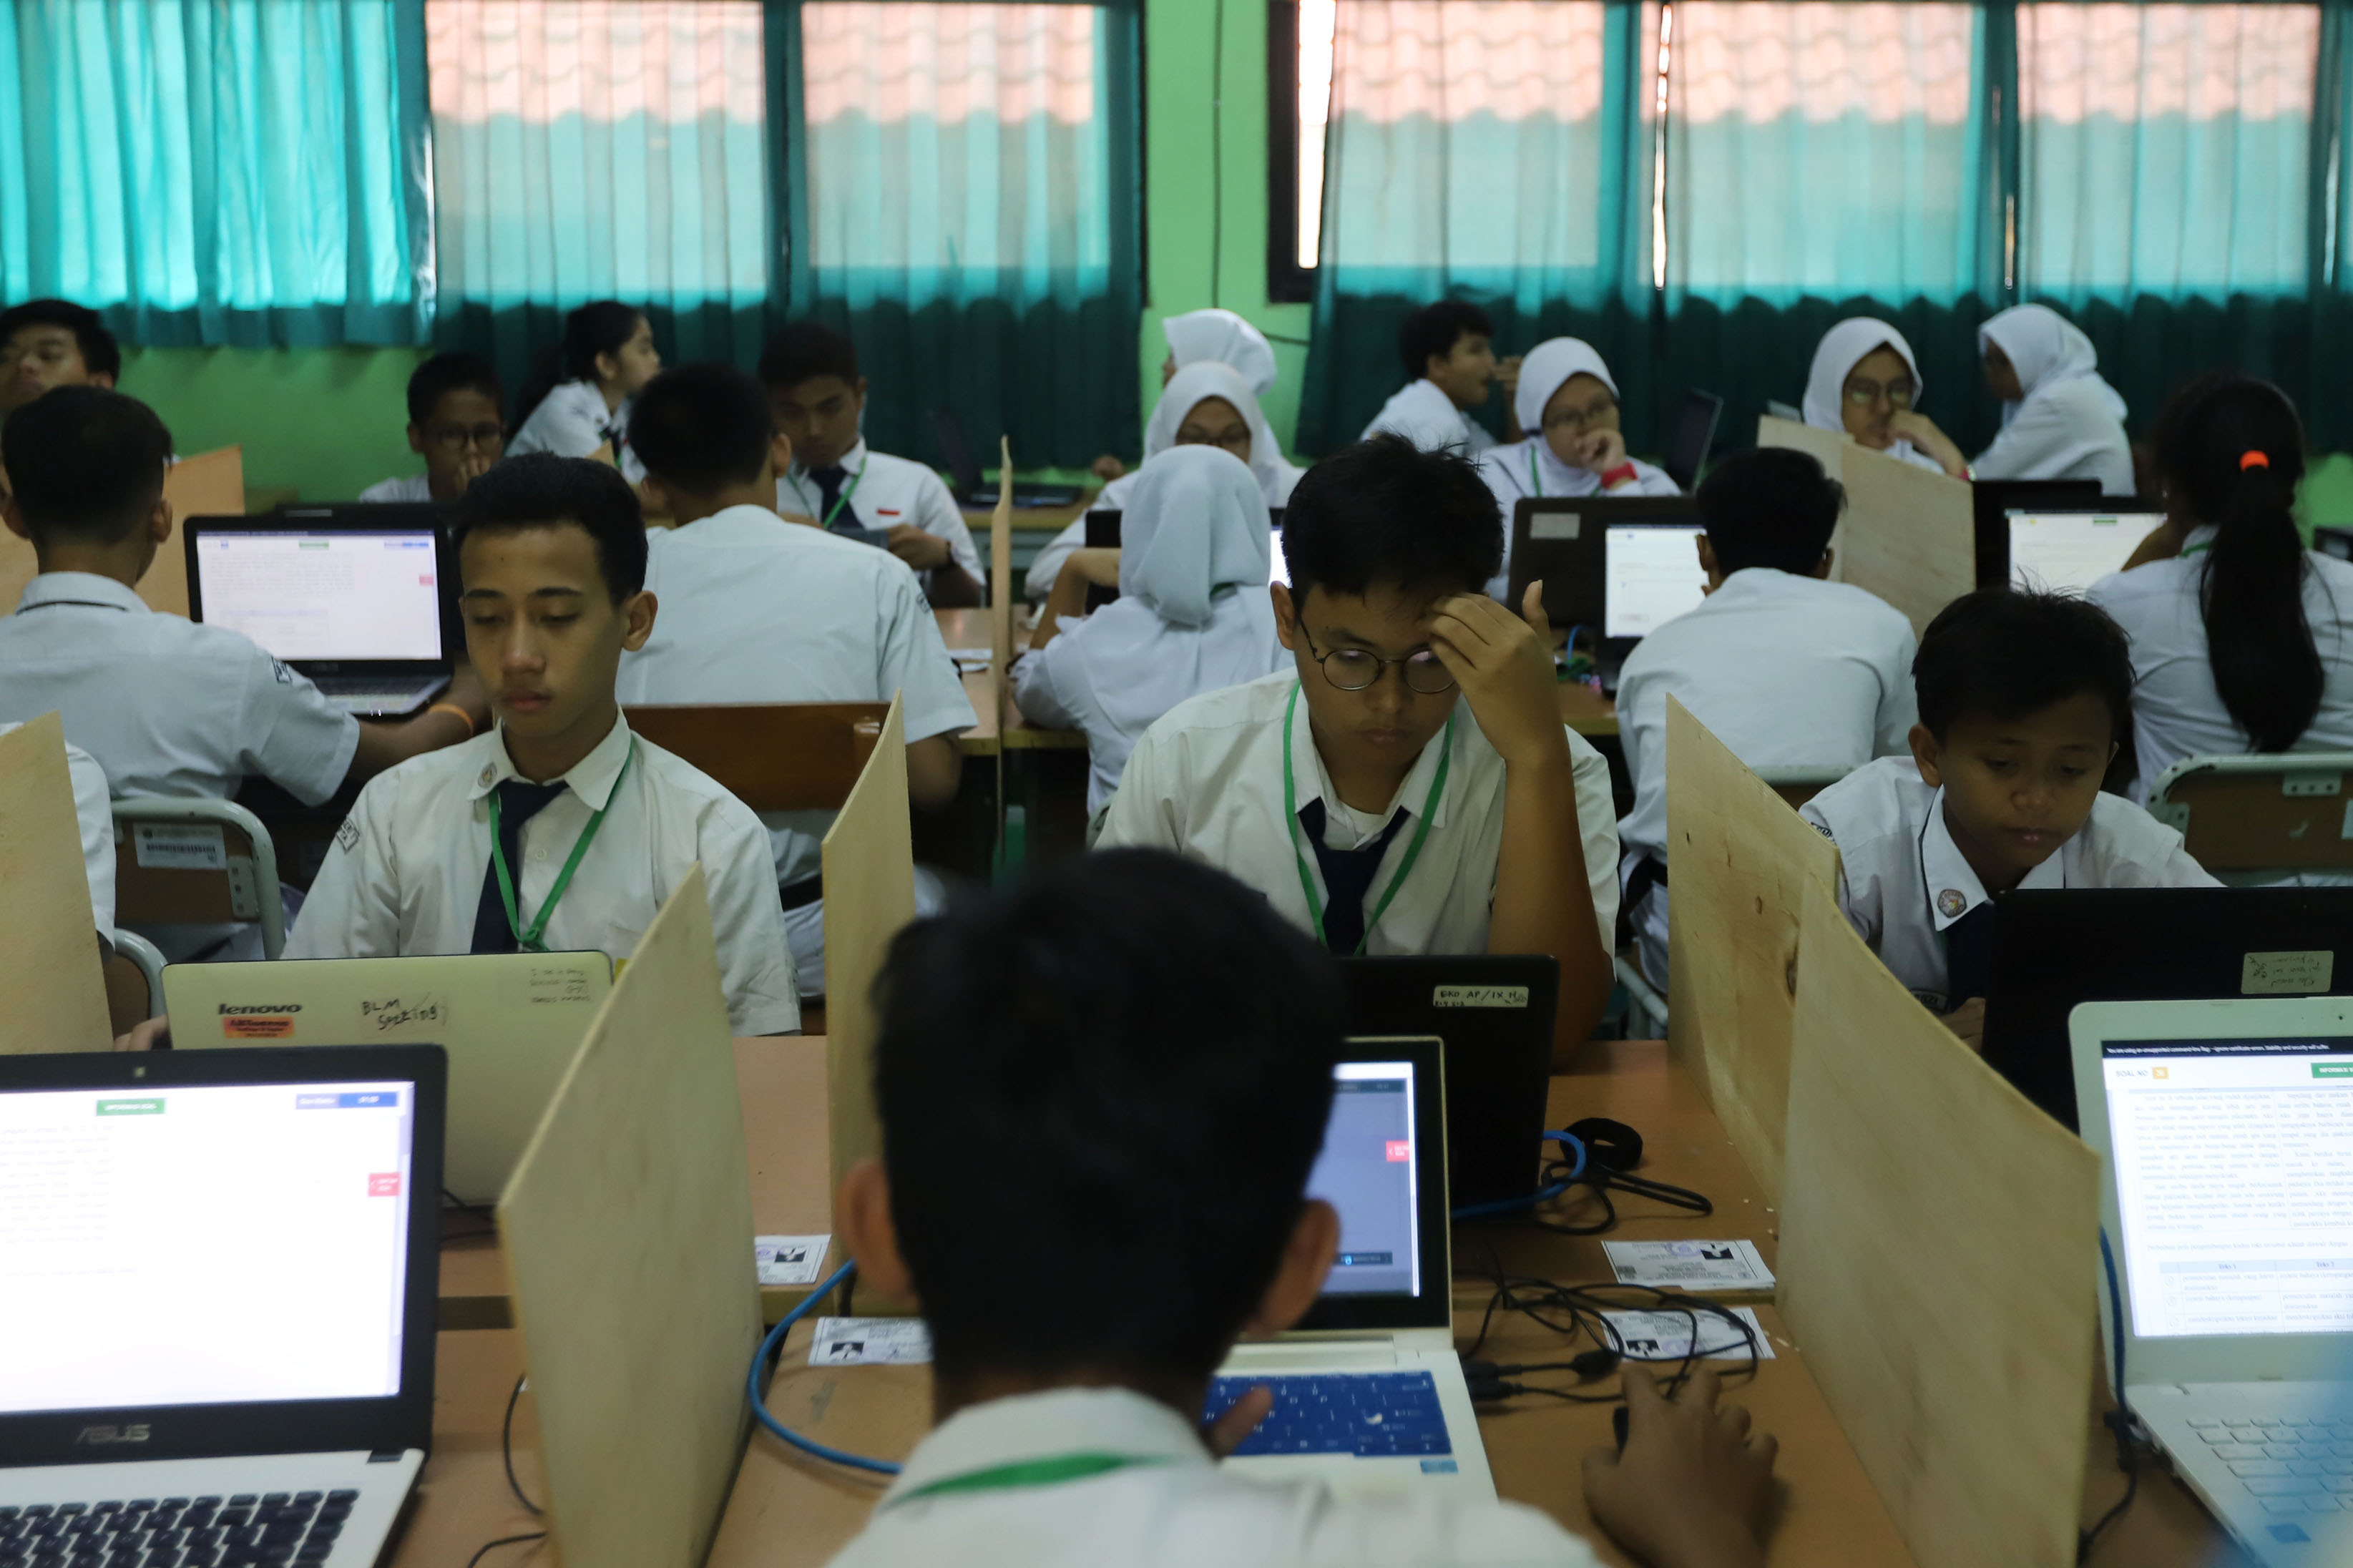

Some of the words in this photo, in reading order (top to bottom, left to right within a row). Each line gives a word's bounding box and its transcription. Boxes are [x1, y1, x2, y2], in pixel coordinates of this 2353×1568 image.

[218, 1003, 303, 1015] lenovo
[361, 998, 400, 1016] BLM
[74, 1424, 152, 1444] ASUS
